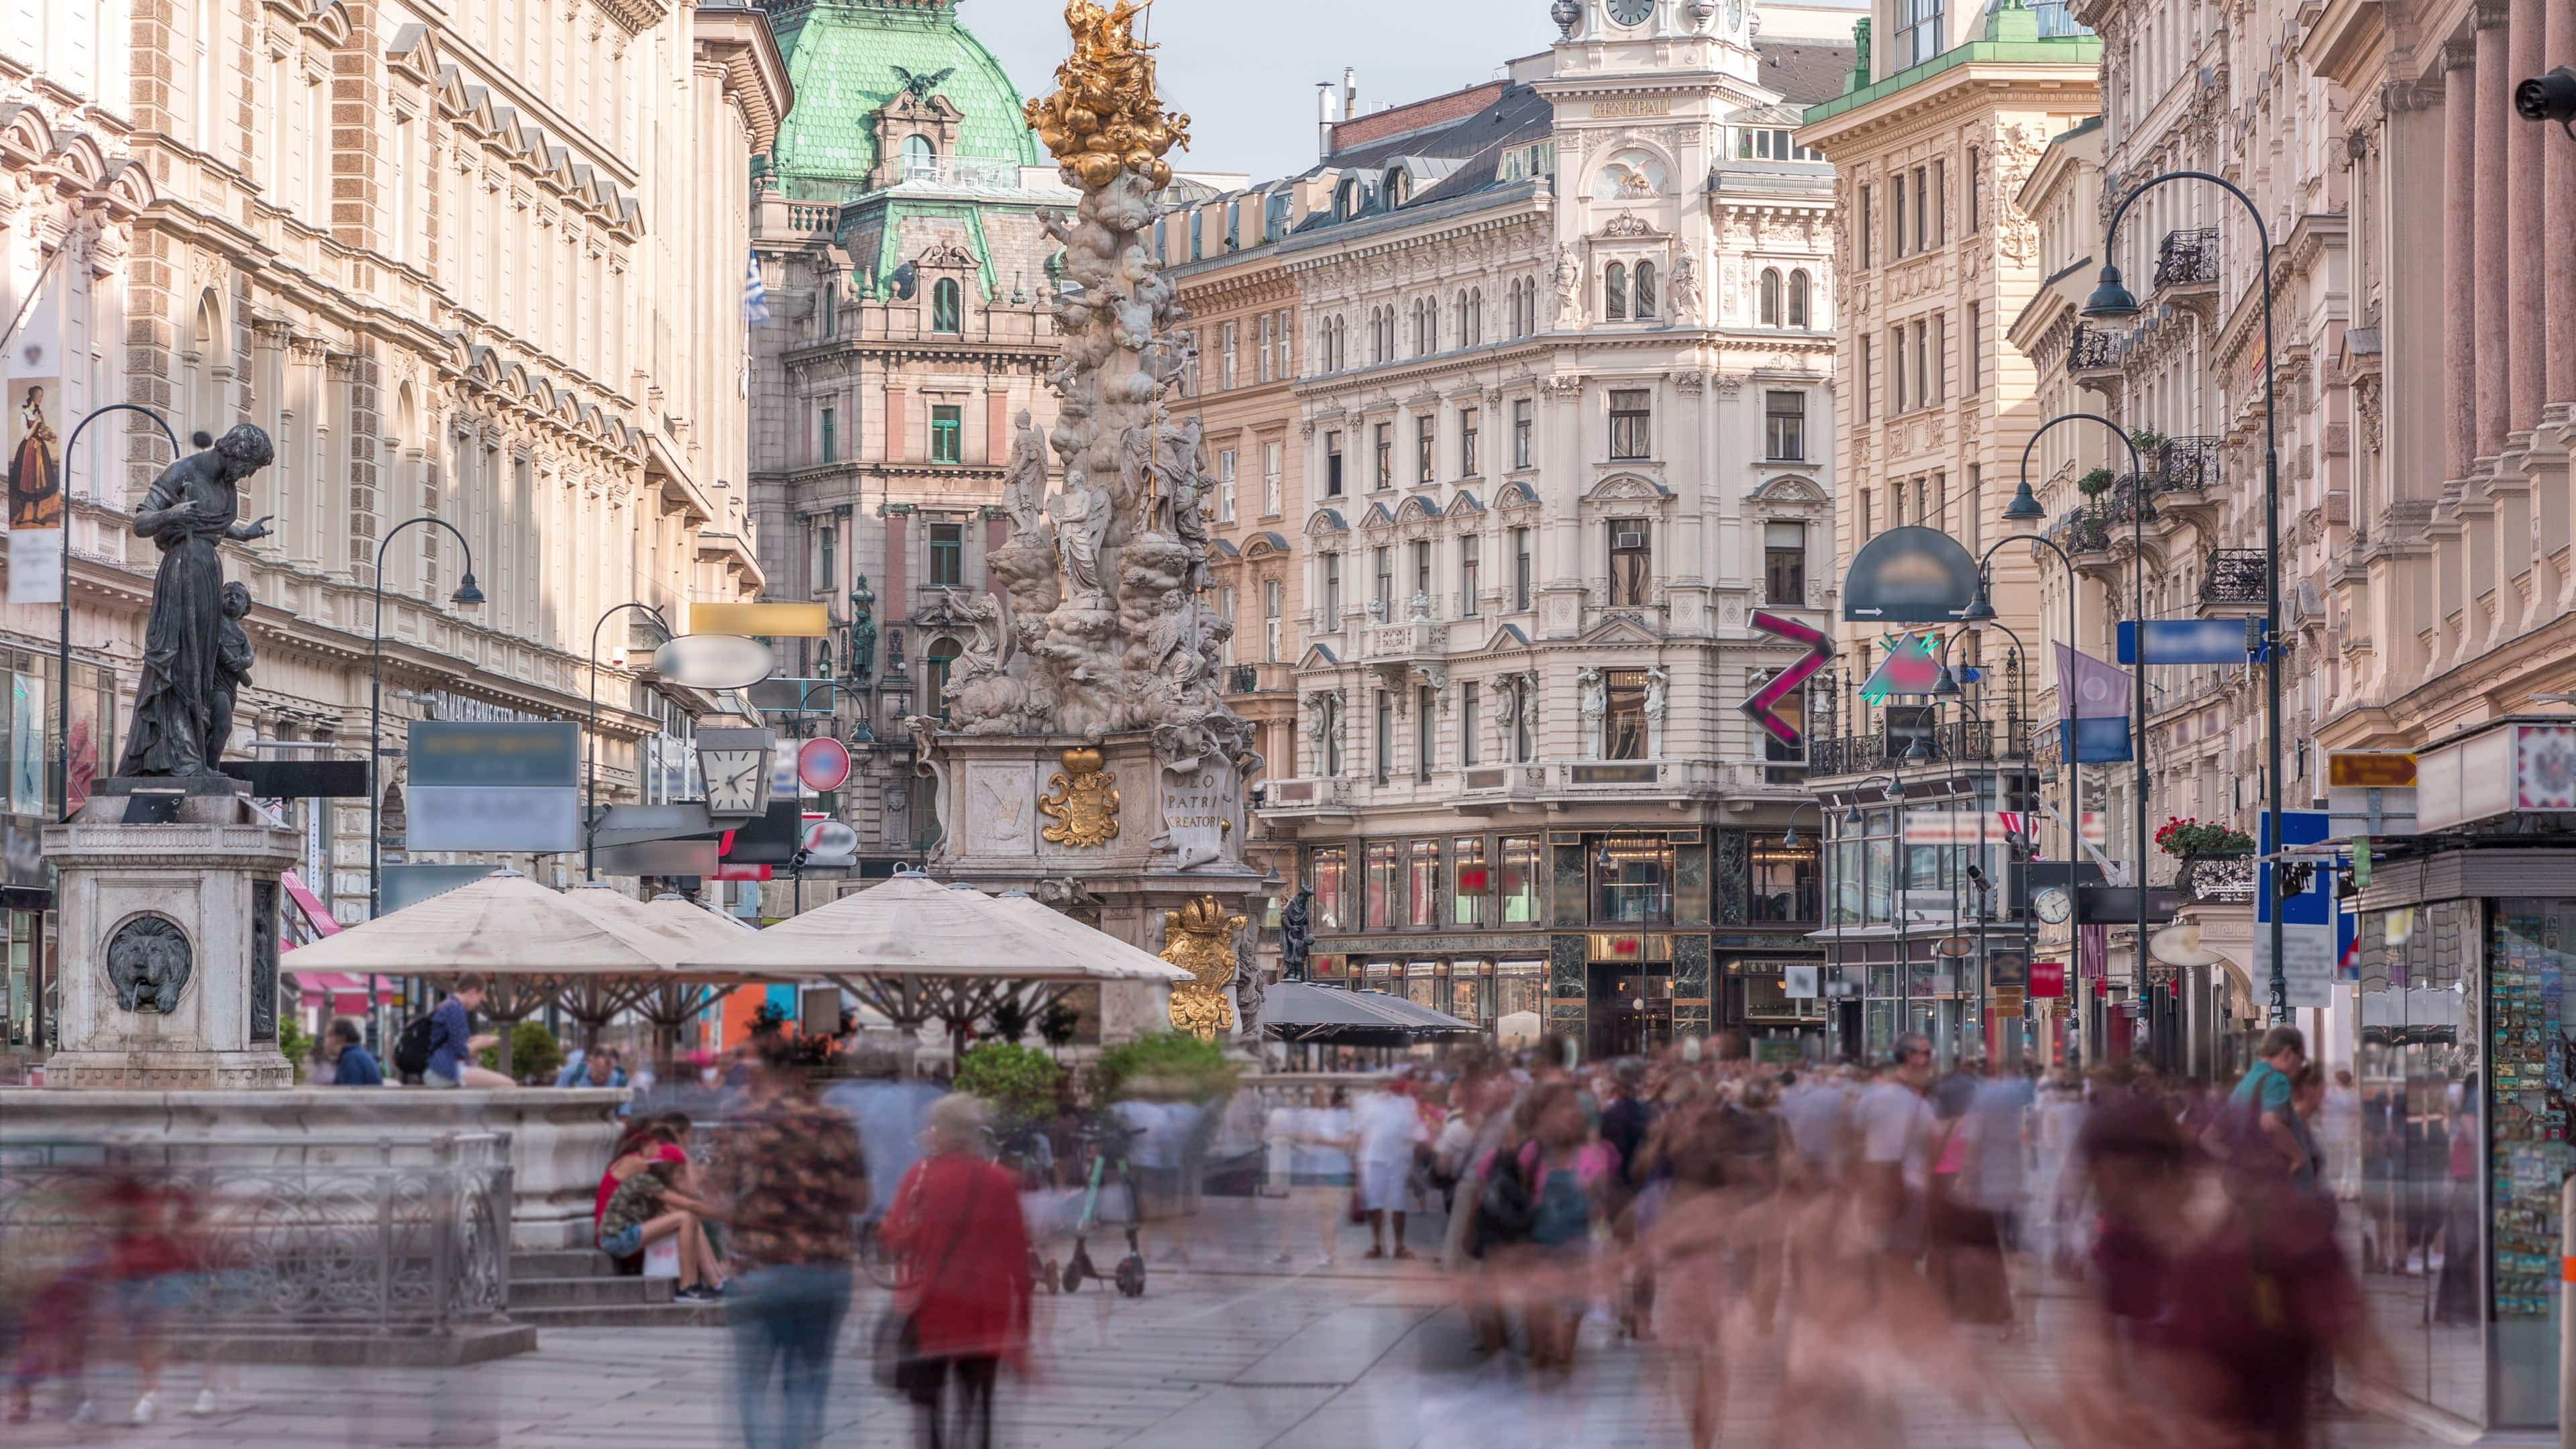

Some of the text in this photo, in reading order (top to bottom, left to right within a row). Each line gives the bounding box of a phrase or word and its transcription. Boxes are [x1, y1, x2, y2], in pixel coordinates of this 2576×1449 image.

[1591, 97, 1671, 118] GENERALI
[1174, 773, 1214, 788] DEO
[1168, 795, 1218, 808] PATRI
[1167, 816, 1220, 828] CREATORI
